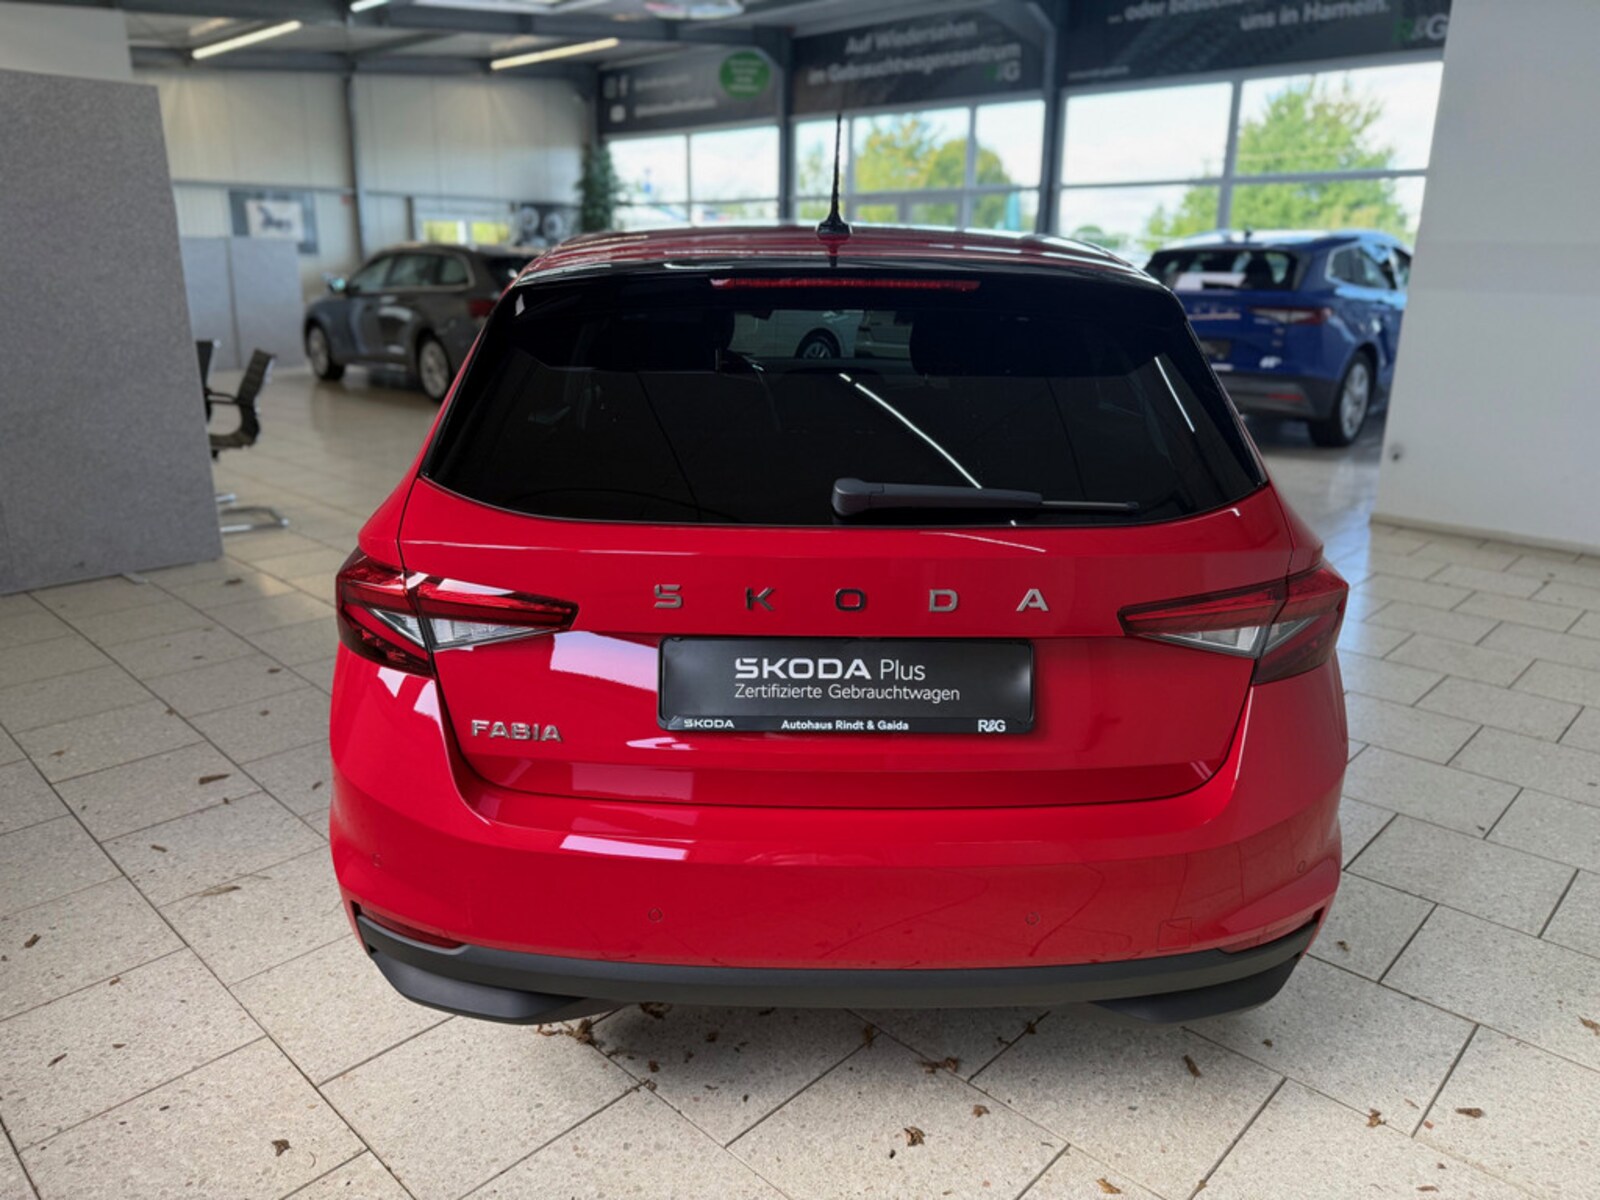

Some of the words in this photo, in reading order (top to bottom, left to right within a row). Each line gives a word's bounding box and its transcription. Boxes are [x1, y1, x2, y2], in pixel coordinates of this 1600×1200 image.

[1240, 12, 1276, 31] uns
[1279, 6, 1299, 25] in
[735, 657, 872, 680] SKODA
[880, 658, 926, 681] Plus
[734, 683, 823, 699] Zertifizierte
[827, 684, 960, 704] Gebrauchtwagen
[471, 719, 562, 742] FABIA
[683, 719, 735, 729] SKODA
[781, 720, 833, 731] Autohaus
[835, 720, 864, 731] Rindt
[866, 720, 875, 731] &
[877, 720, 909, 731] Gaida
[977, 719, 1006, 733] R&G
